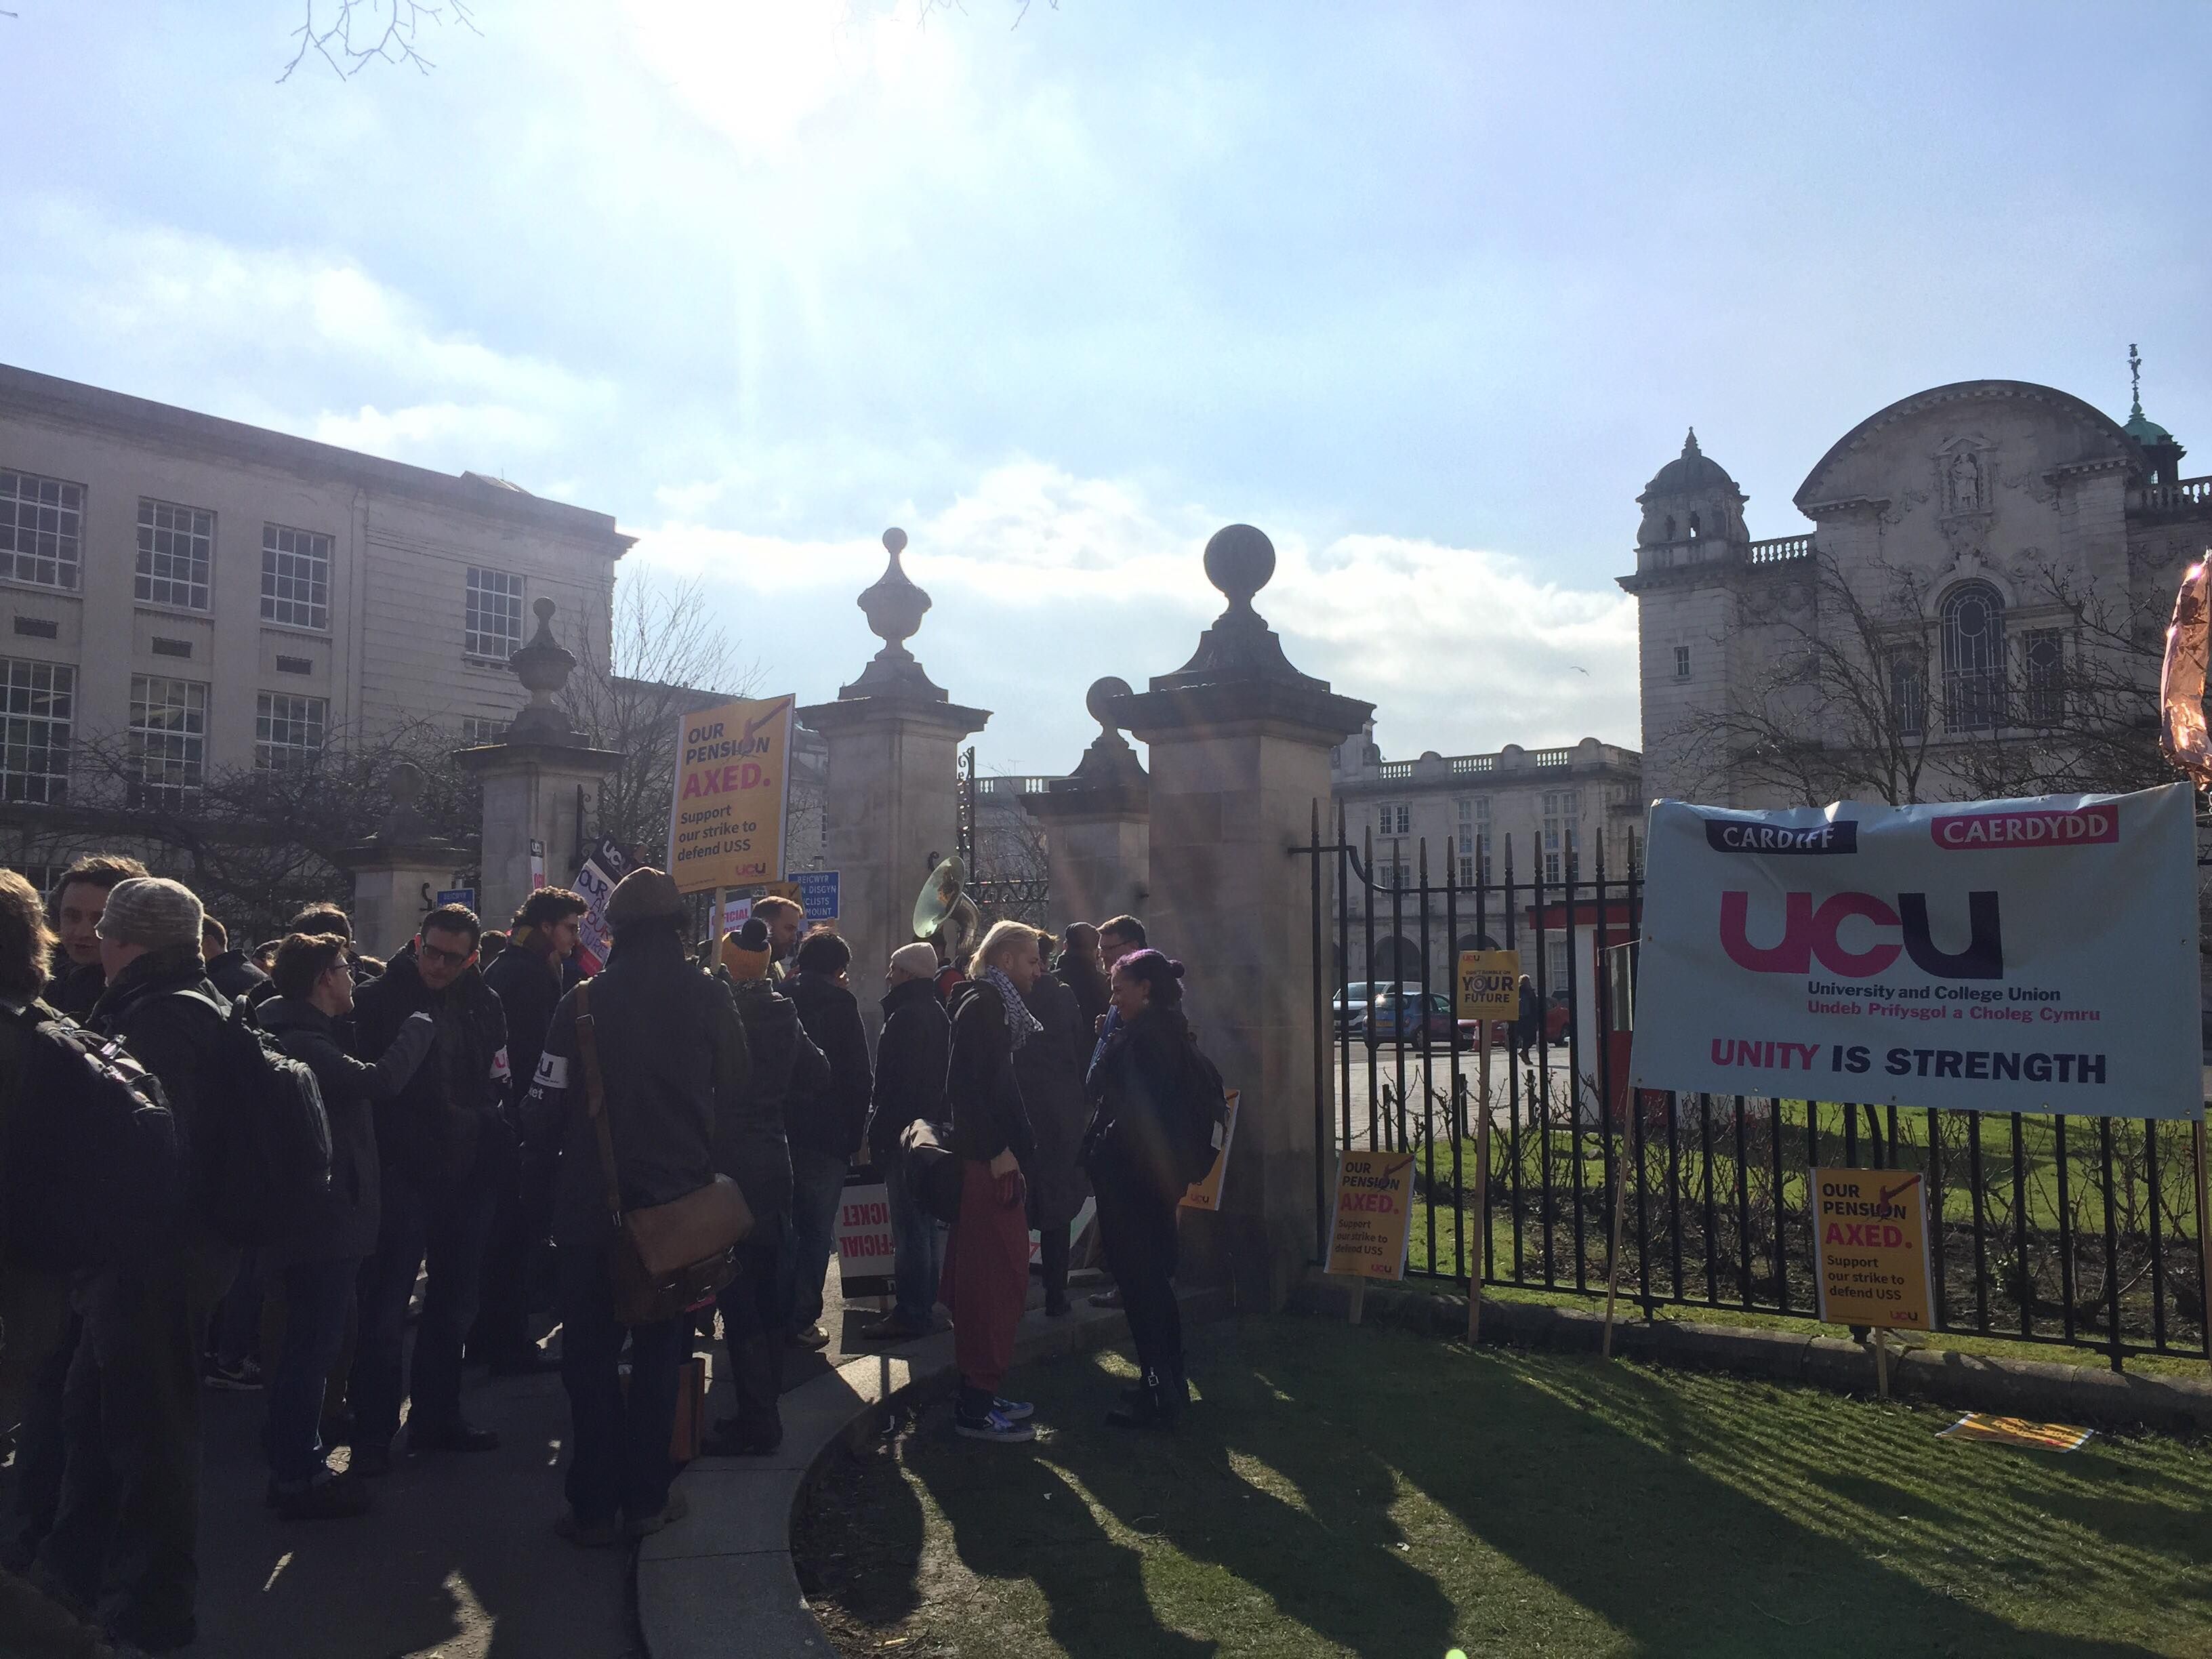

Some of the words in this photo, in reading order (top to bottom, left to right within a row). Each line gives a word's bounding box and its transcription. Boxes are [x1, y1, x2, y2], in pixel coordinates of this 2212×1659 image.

[688, 722, 724, 744] OUR
[686, 737, 771, 766] PENSION
[682, 762, 771, 800] AXED.
[680, 804, 731, 825] Support
[678, 828, 701, 843] our
[703, 821, 739, 839] strike
[743, 820, 757, 834] to
[1723, 825, 1835, 851] CARDIFF
[1943, 813, 2108, 844] CAERDYDD
[678, 840, 720, 861] defend
[724, 839, 751, 853] USS
[579, 869, 608, 900] OUR
[798, 875, 829, 884] BEICWYR
[809, 885, 836, 894] DISGYN
[804, 897, 830, 906] CLISTS
[806, 907, 832, 916] MOUNT
[1462, 976, 1514, 993] YOUR
[1808, 981, 1896, 1000] University
[1898, 986, 1930, 999] and
[1934, 985, 2003, 1003] College
[2008, 987, 2061, 1002] Union
[1465, 994, 1510, 1003] FUTURE
[1807, 1000, 1861, 1015] Undeb
[1868, 1002, 1946, 1021] Prifysgol
[1952, 1009, 1963, 1019] a
[1969, 1006, 2033, 1023] Choleg
[2040, 1008, 2100, 1024] Cymru
[1711, 1038, 1821, 1070] UNITY
[1832, 1044, 1871, 1073] IS
[1885, 1047, 2106, 1084] STRENGTH
[1345, 1162, 1371, 1174] OUR
[1822, 1183, 1860, 1198] OUR
[1340, 1193, 1399, 1215] AXED.
[1338, 1219, 1372, 1231] Support
[1336, 1232, 1351, 1241] our
[1351, 1231, 1376, 1242] strike
[1378, 1233, 1388, 1243] to
[1825, 1223, 1912, 1249] AXED.
[1334, 1243, 1362, 1254] defend
[1364, 1246, 1383, 1256] USS
[1827, 1255, 1879, 1269] Support
[1828, 1271, 1849, 1282] our
[1853, 1272, 1888, 1284] strike
[1891, 1274, 1904, 1285] to
[1830, 1286, 1872, 1298] defend
[1877, 1289, 1902, 1300] USS
